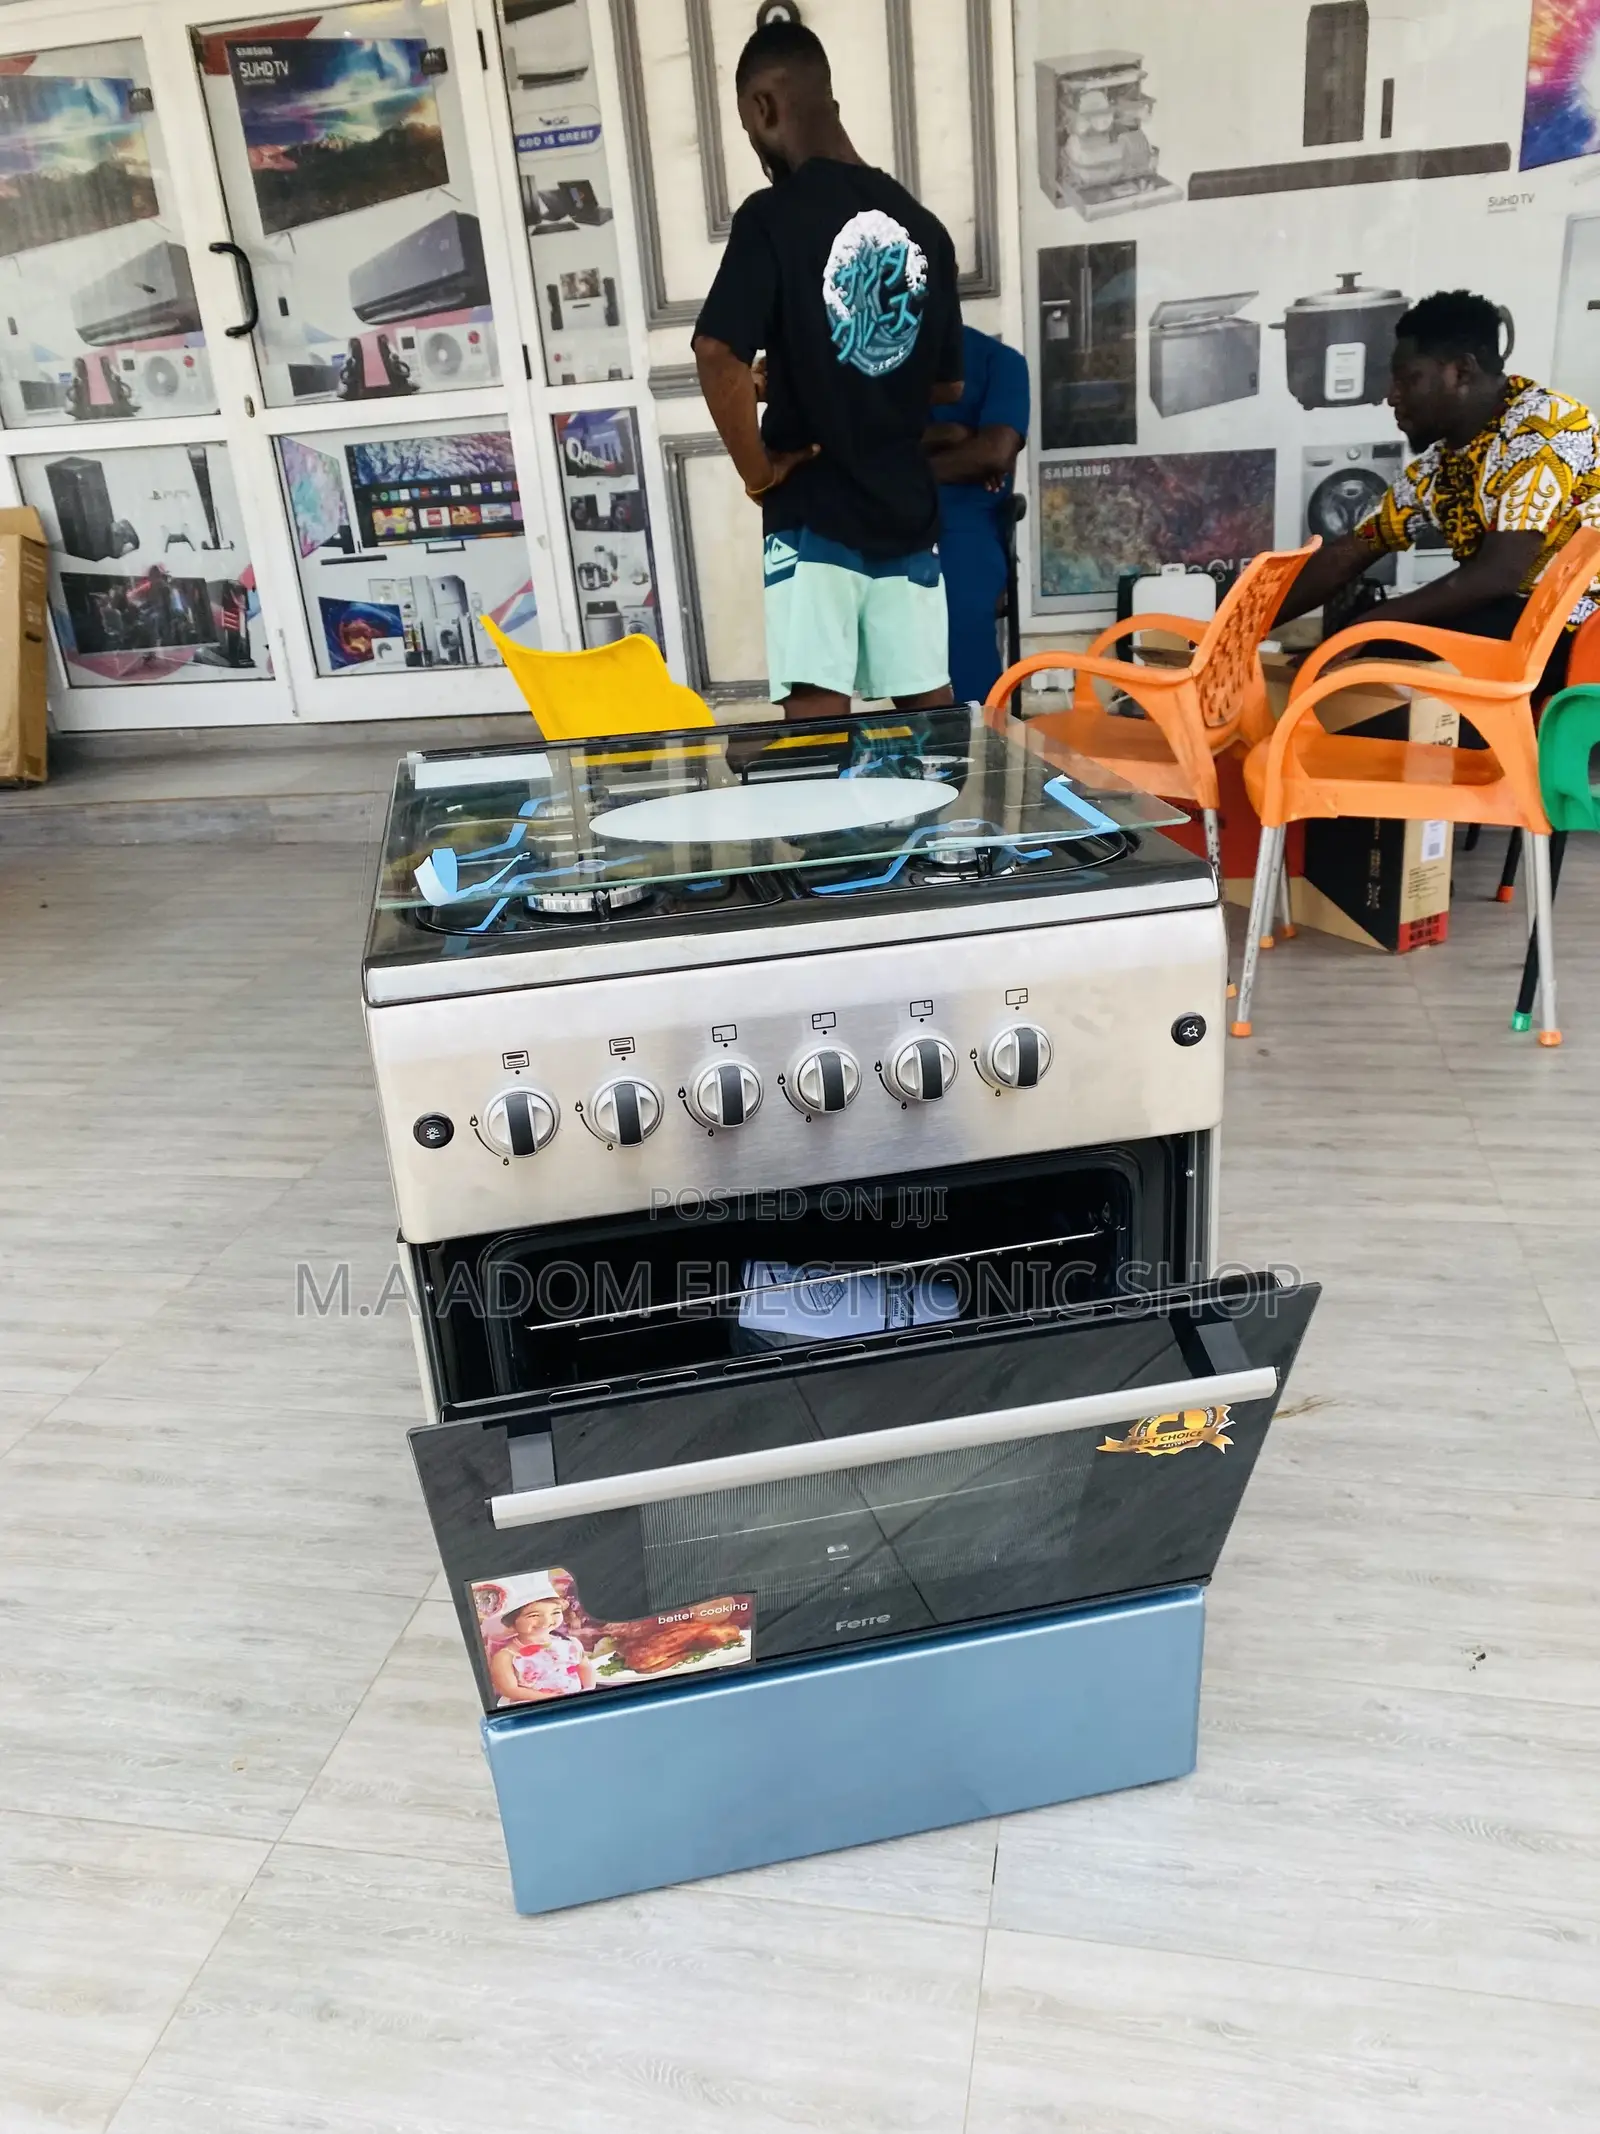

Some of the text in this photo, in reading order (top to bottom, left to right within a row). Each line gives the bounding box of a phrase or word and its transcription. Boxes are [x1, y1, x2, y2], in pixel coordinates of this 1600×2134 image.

[239, 60, 289, 78] SUHD TV
[1044, 463, 1111, 481] SAMSUNG
[1128, 1437, 1158, 1446] BEST
[1160, 1430, 1204, 1442] CHOICE
[657, 1602, 749, 1625] better cooking
[836, 1614, 891, 1632] Ferre
